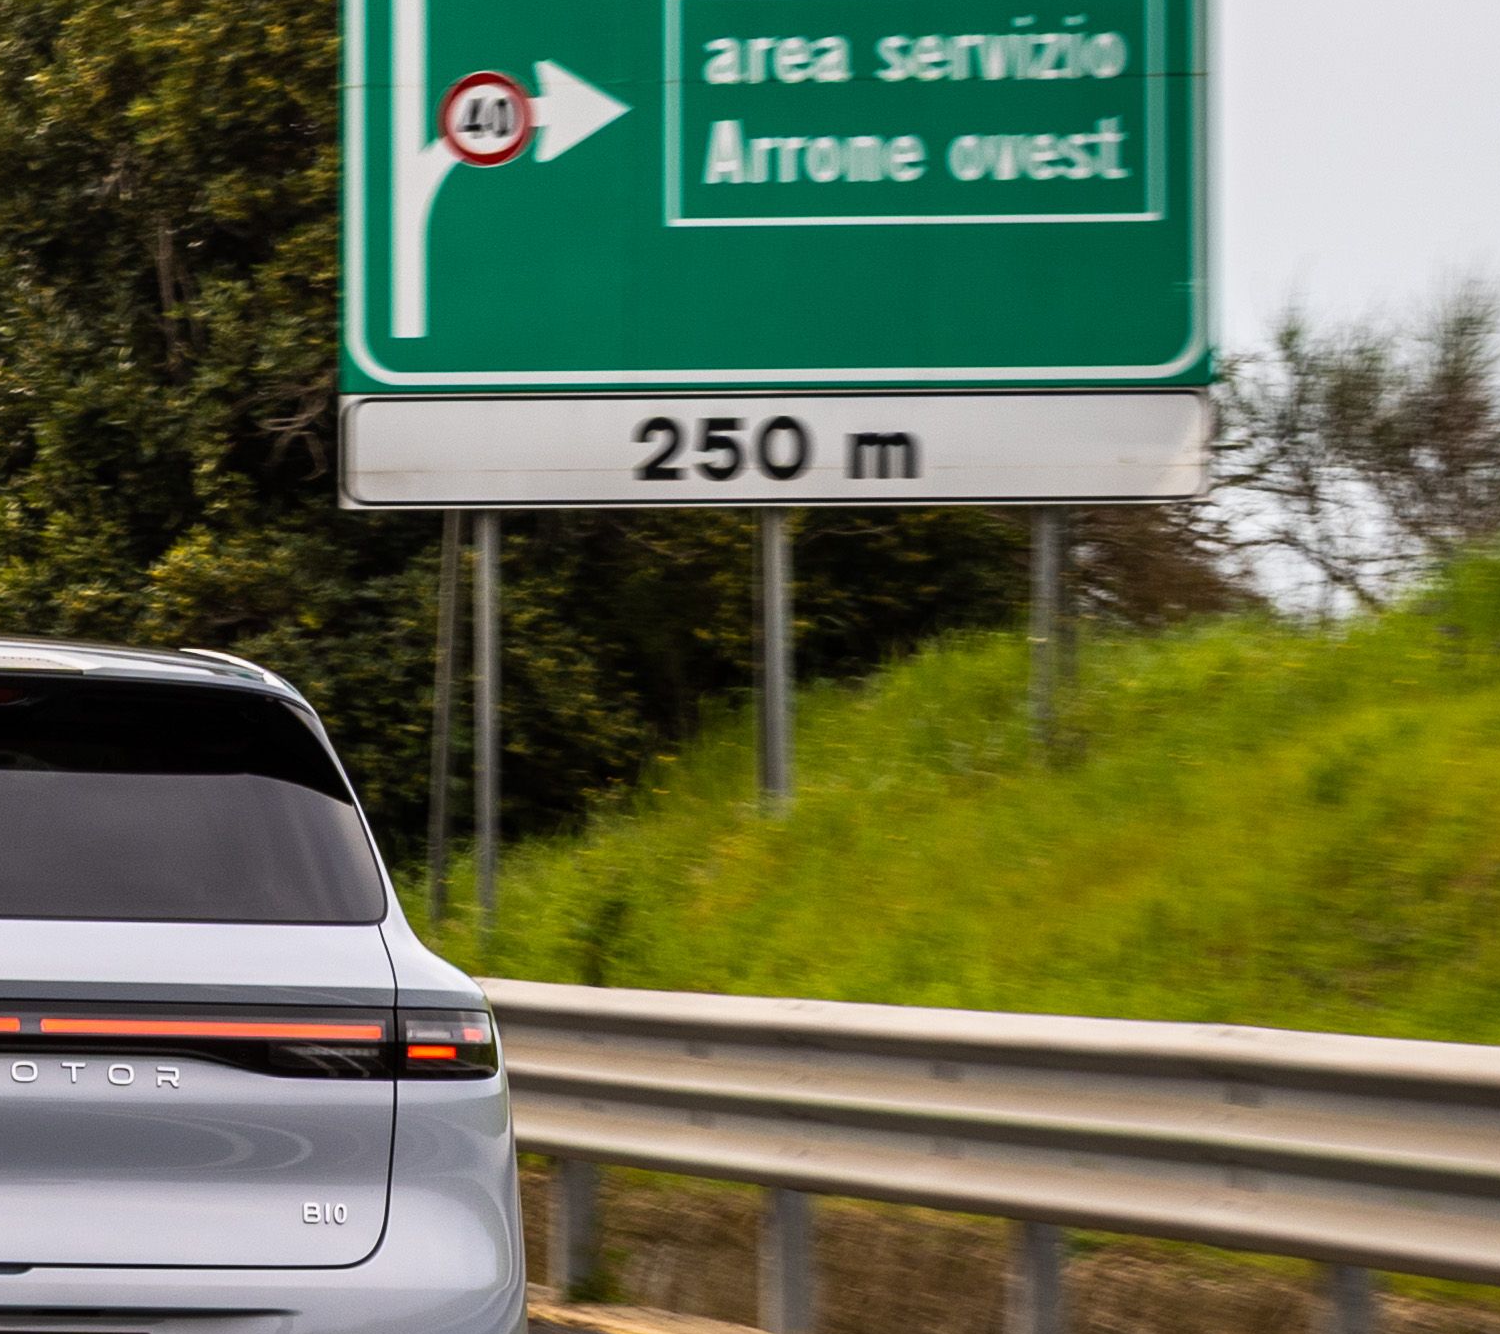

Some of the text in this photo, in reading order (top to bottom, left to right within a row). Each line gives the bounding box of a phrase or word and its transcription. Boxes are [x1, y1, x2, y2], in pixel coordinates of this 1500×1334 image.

[704, 14, 1129, 84] area servizio
[458, 97, 517, 140] 40
[704, 116, 1132, 184] Arrone ovest
[631, 416, 921, 481] 250 m
[302, 1201, 348, 1225] B10
